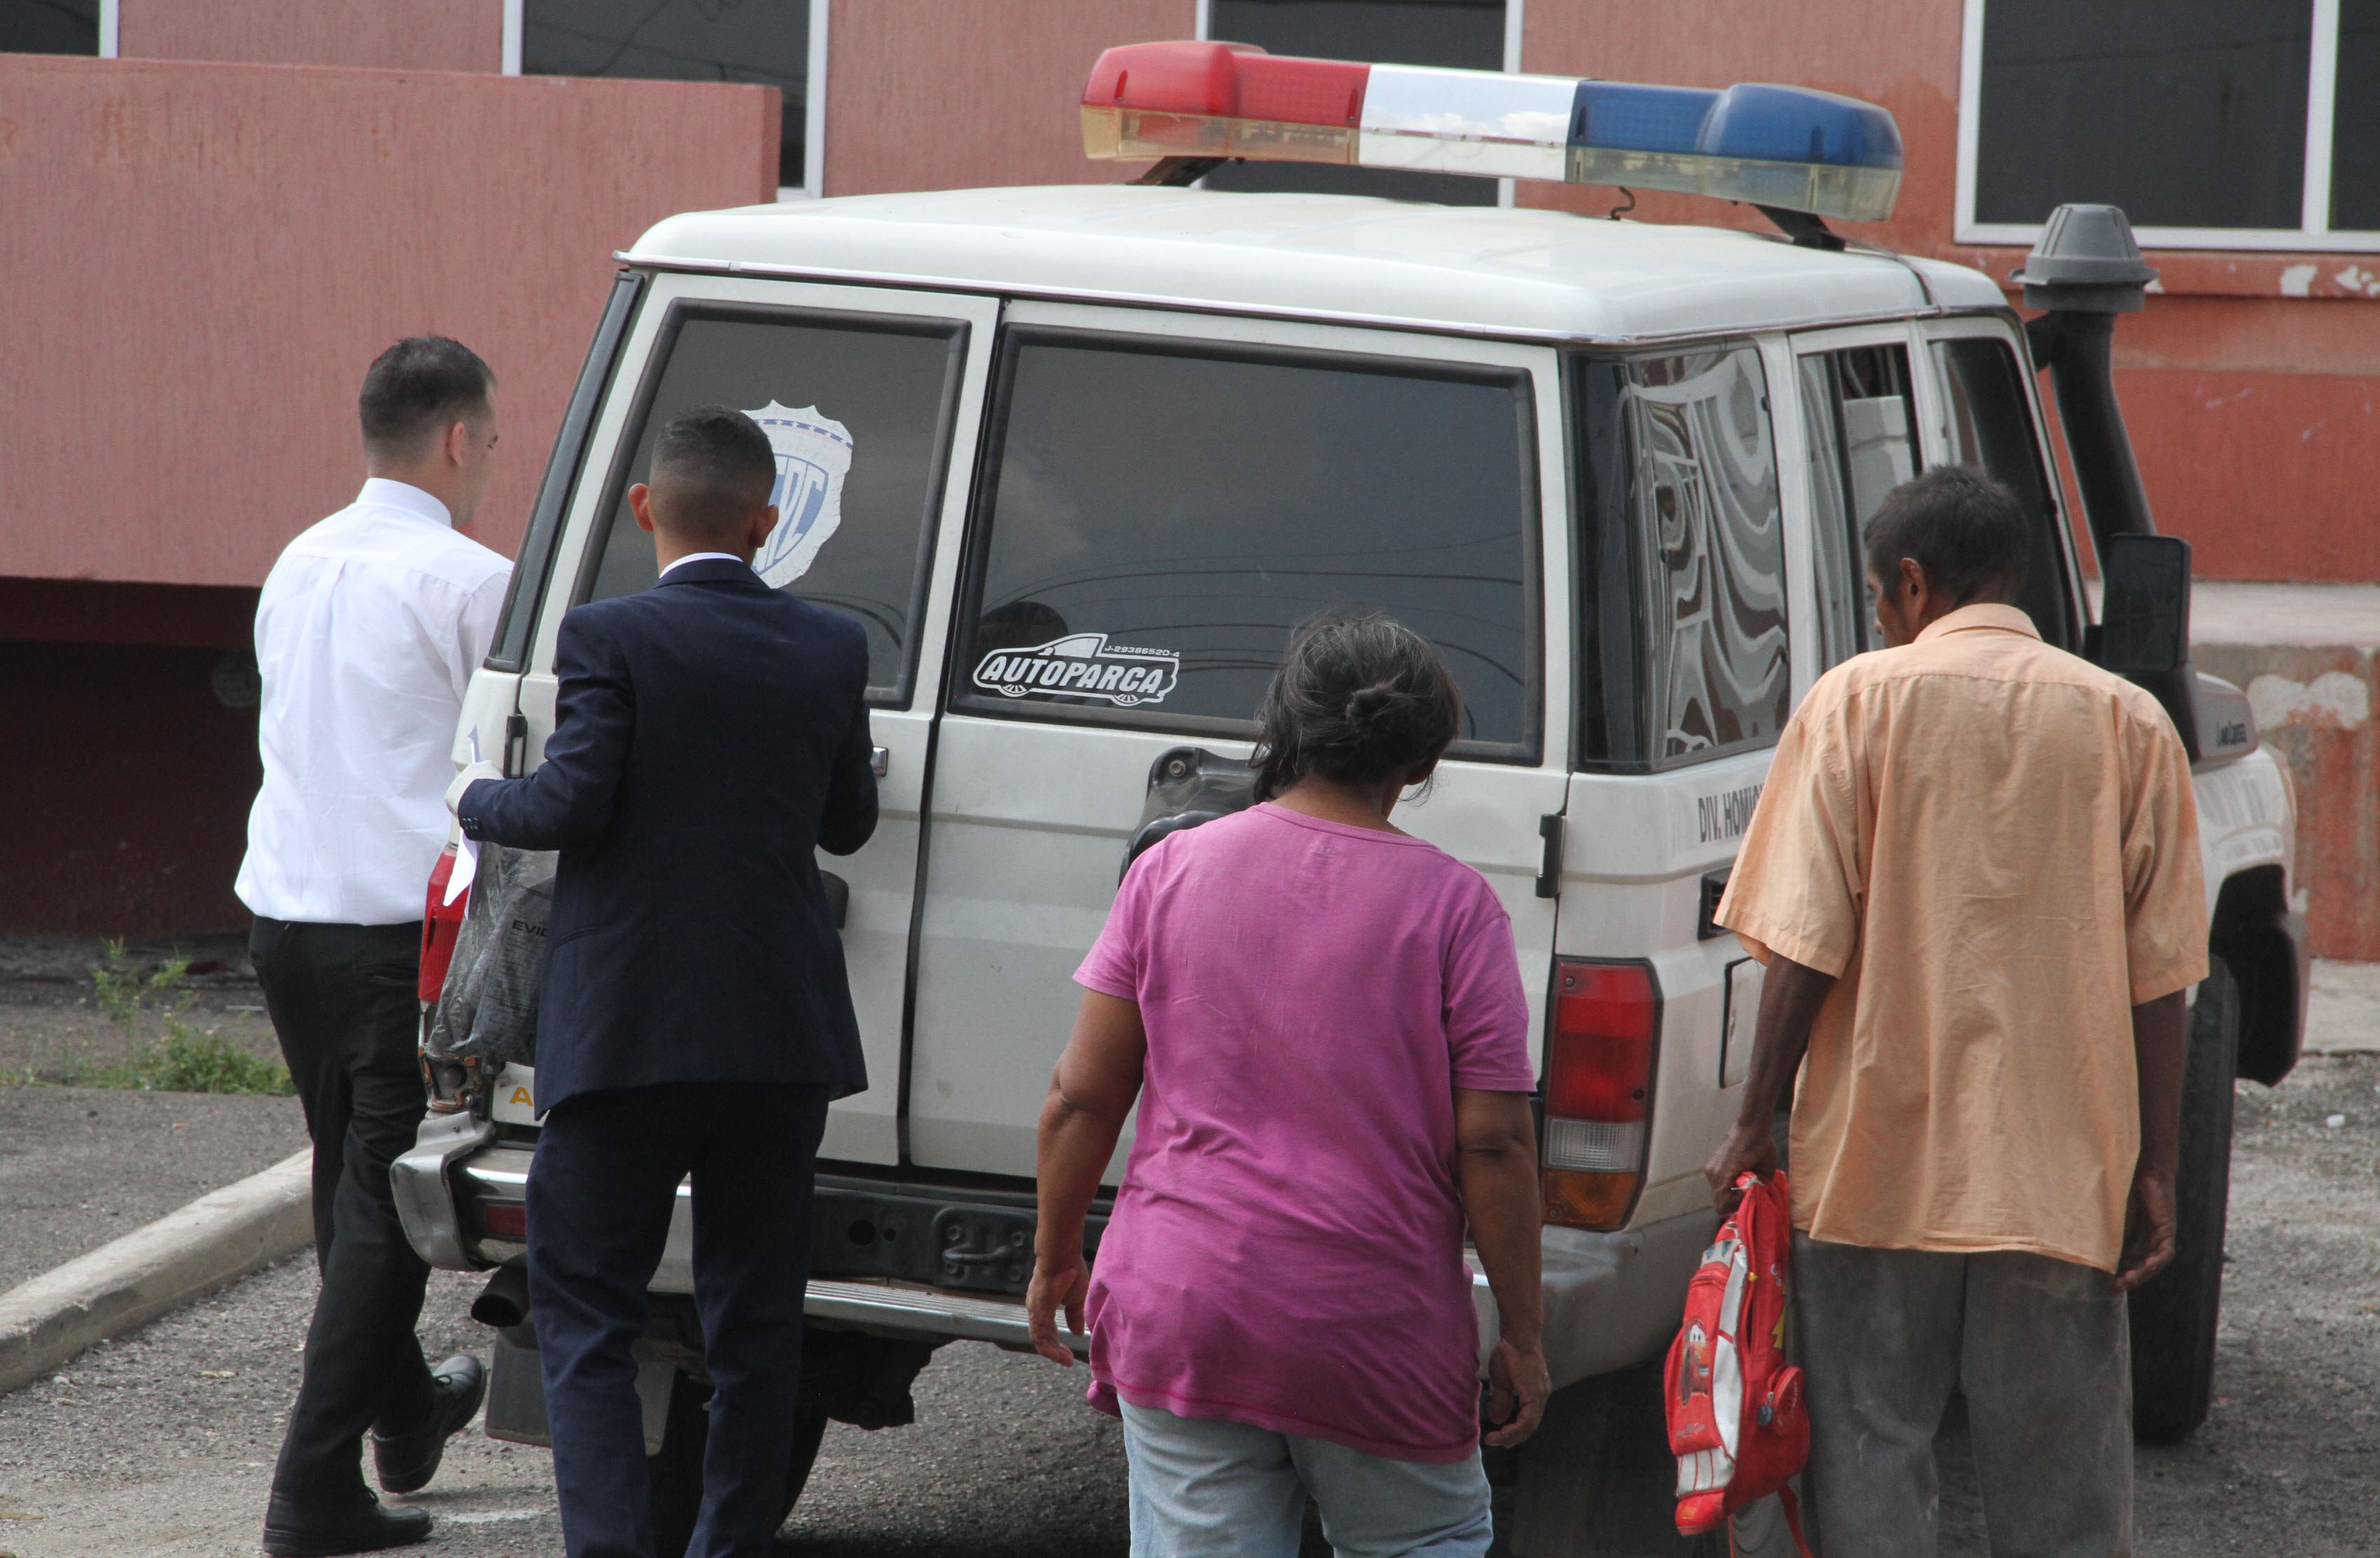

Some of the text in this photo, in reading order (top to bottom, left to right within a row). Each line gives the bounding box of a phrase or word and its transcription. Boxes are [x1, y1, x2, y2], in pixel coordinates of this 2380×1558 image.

[980, 655, 1163, 693] AUTOPARCA
[1698, 784, 1765, 843] DIV. HOMI
[509, 1087, 533, 1107] A
